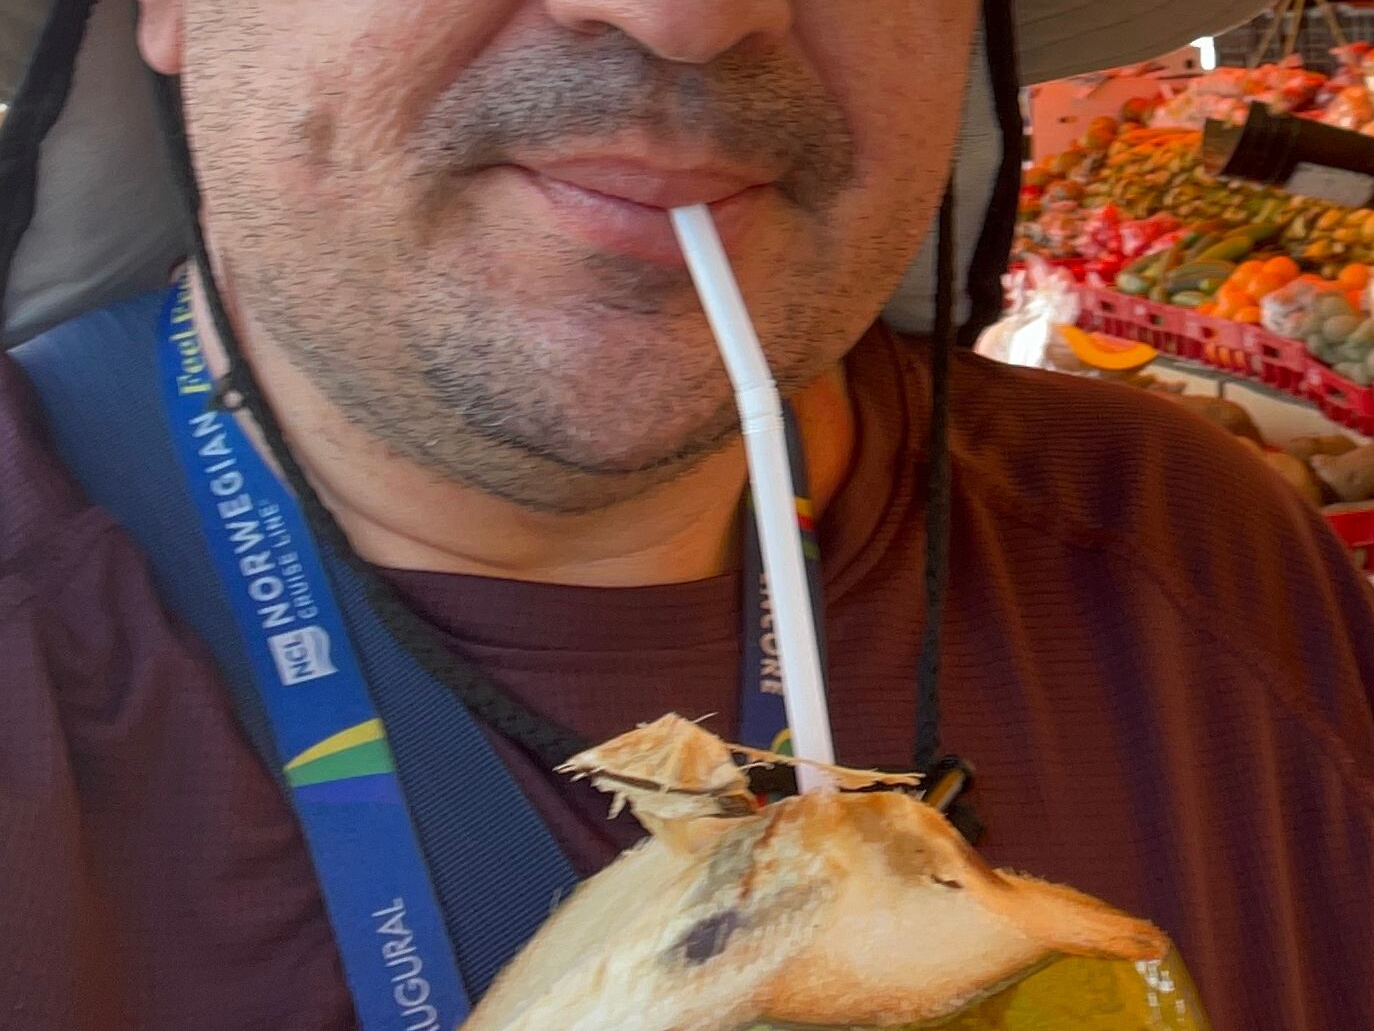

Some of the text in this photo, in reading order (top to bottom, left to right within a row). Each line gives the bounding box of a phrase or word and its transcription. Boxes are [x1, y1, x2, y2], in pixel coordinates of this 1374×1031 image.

[188, 411, 296, 629] NORWEGIAN
[258, 502, 319, 620] CRUISE LINE
[283, 638, 313, 679] NCL
